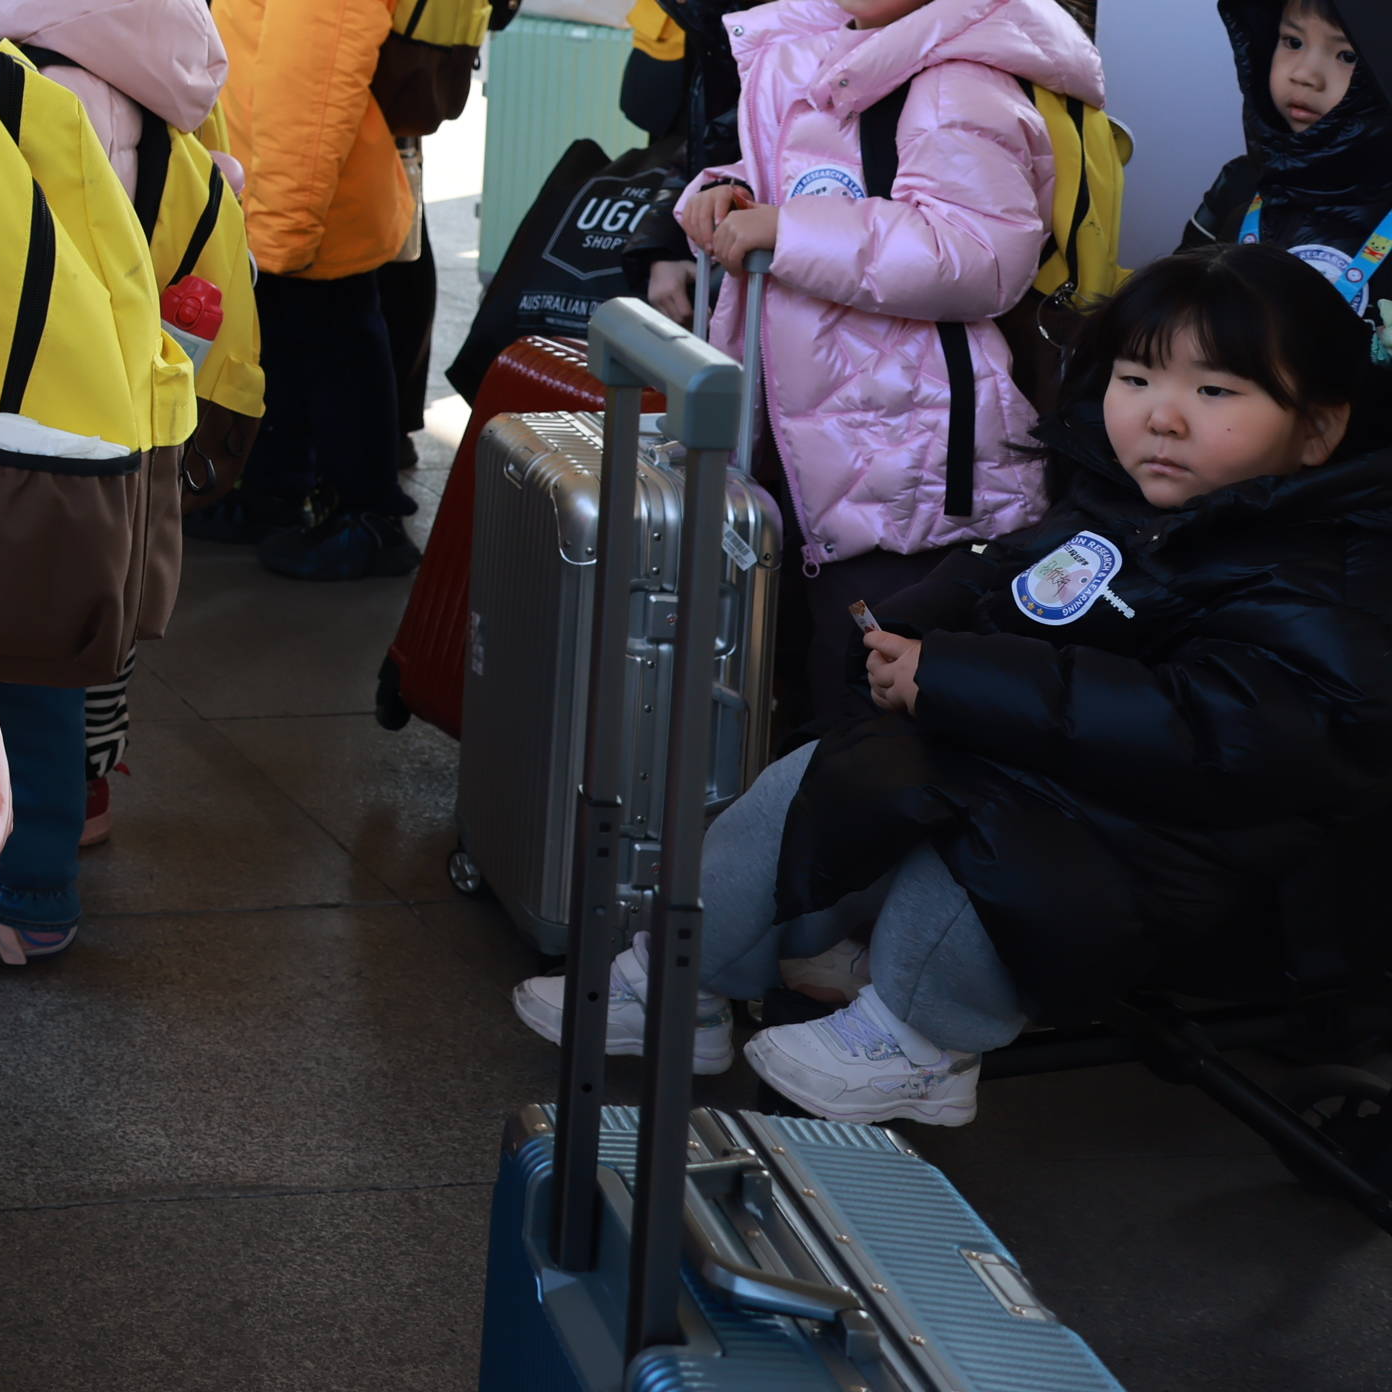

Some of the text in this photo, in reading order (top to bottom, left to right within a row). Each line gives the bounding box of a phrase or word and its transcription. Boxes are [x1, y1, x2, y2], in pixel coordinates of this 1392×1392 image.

[622, 187, 651, 199] THE
[519, 294, 588, 316] AUSTRALIAN
[1062, 579, 1104, 617] LEARNING
